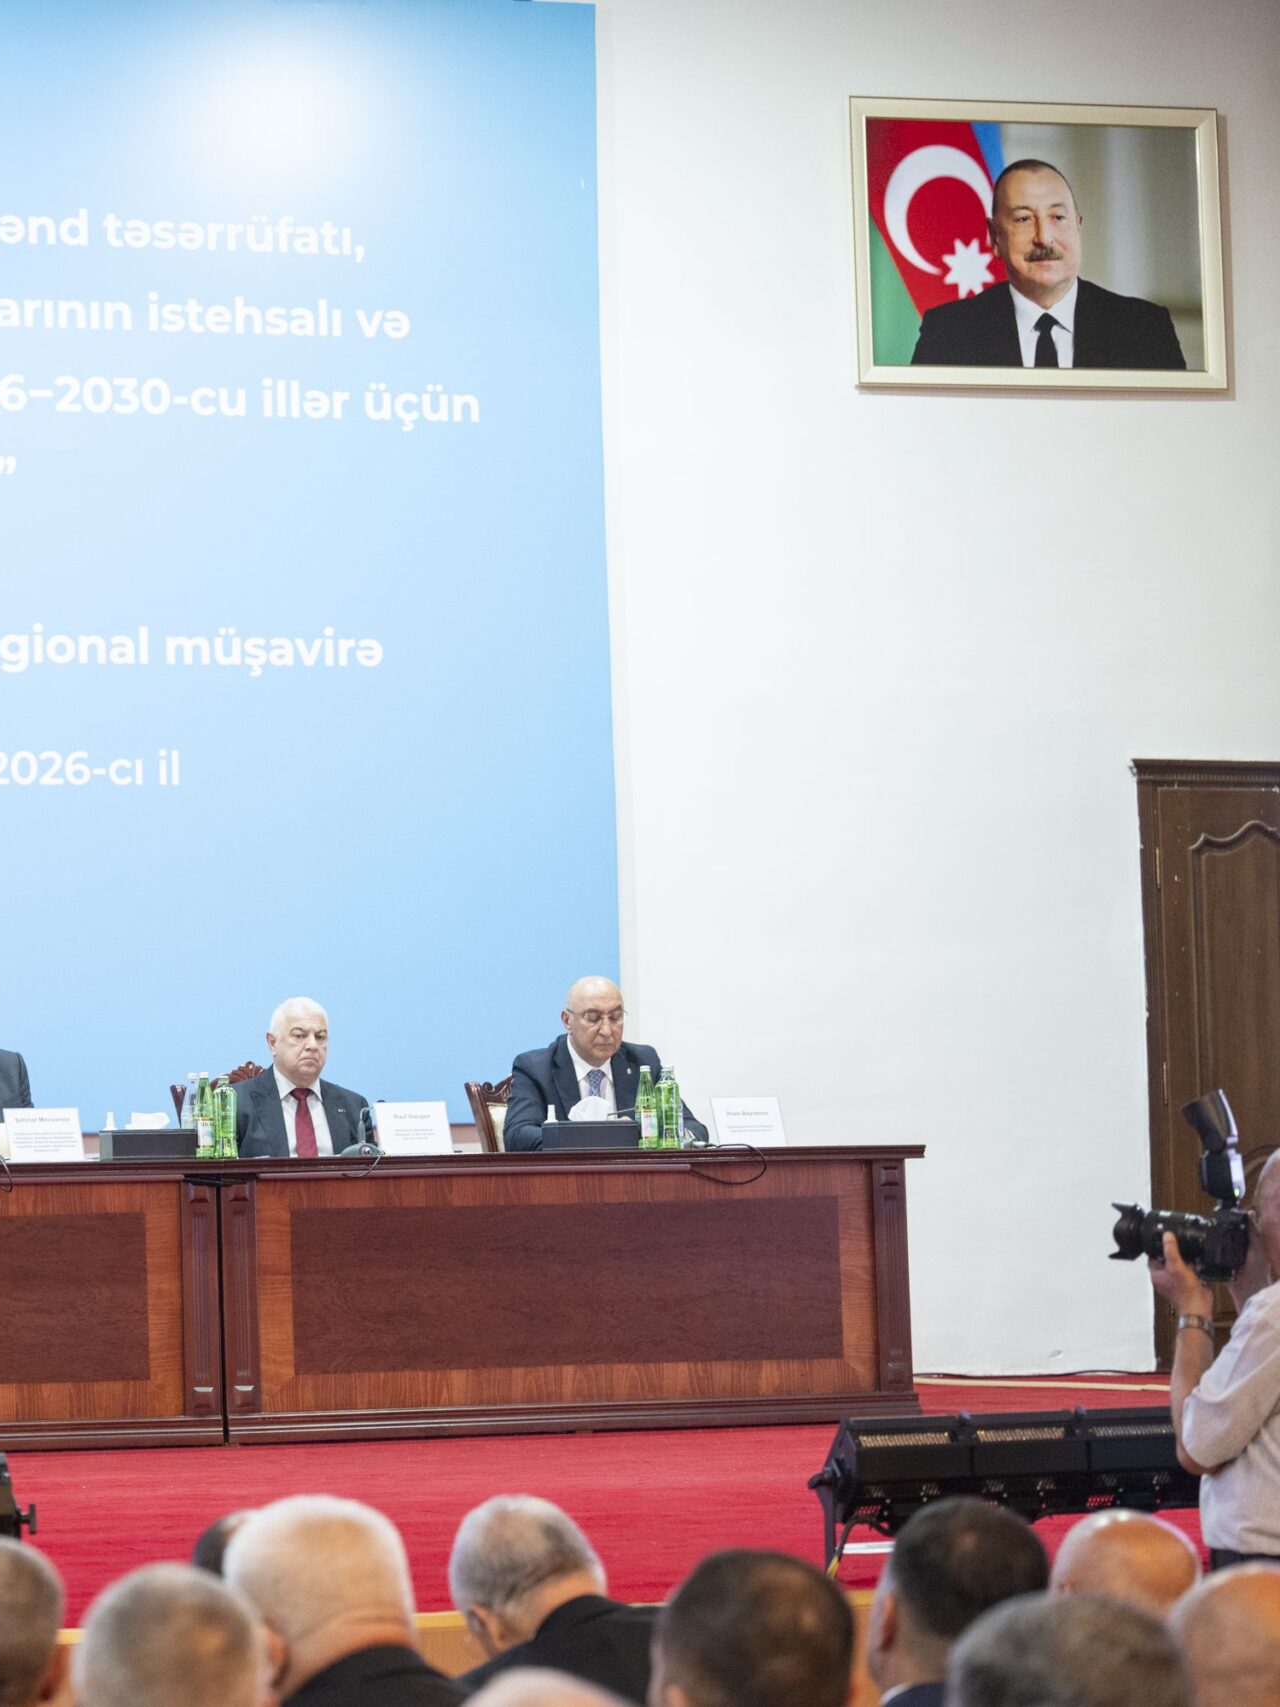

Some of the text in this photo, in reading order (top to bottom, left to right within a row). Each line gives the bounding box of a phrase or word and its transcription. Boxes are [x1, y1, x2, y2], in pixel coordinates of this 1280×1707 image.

[104, 214, 365, 263] təsərrüfatı,
[149, 291, 342, 337] istehsalı
[356, 309, 411, 340] və
[262, 378, 351, 419] illər
[365, 383, 480, 432] üçün
[166, 626, 384, 678] müşavirə
[159, 749, 180, 786] il
